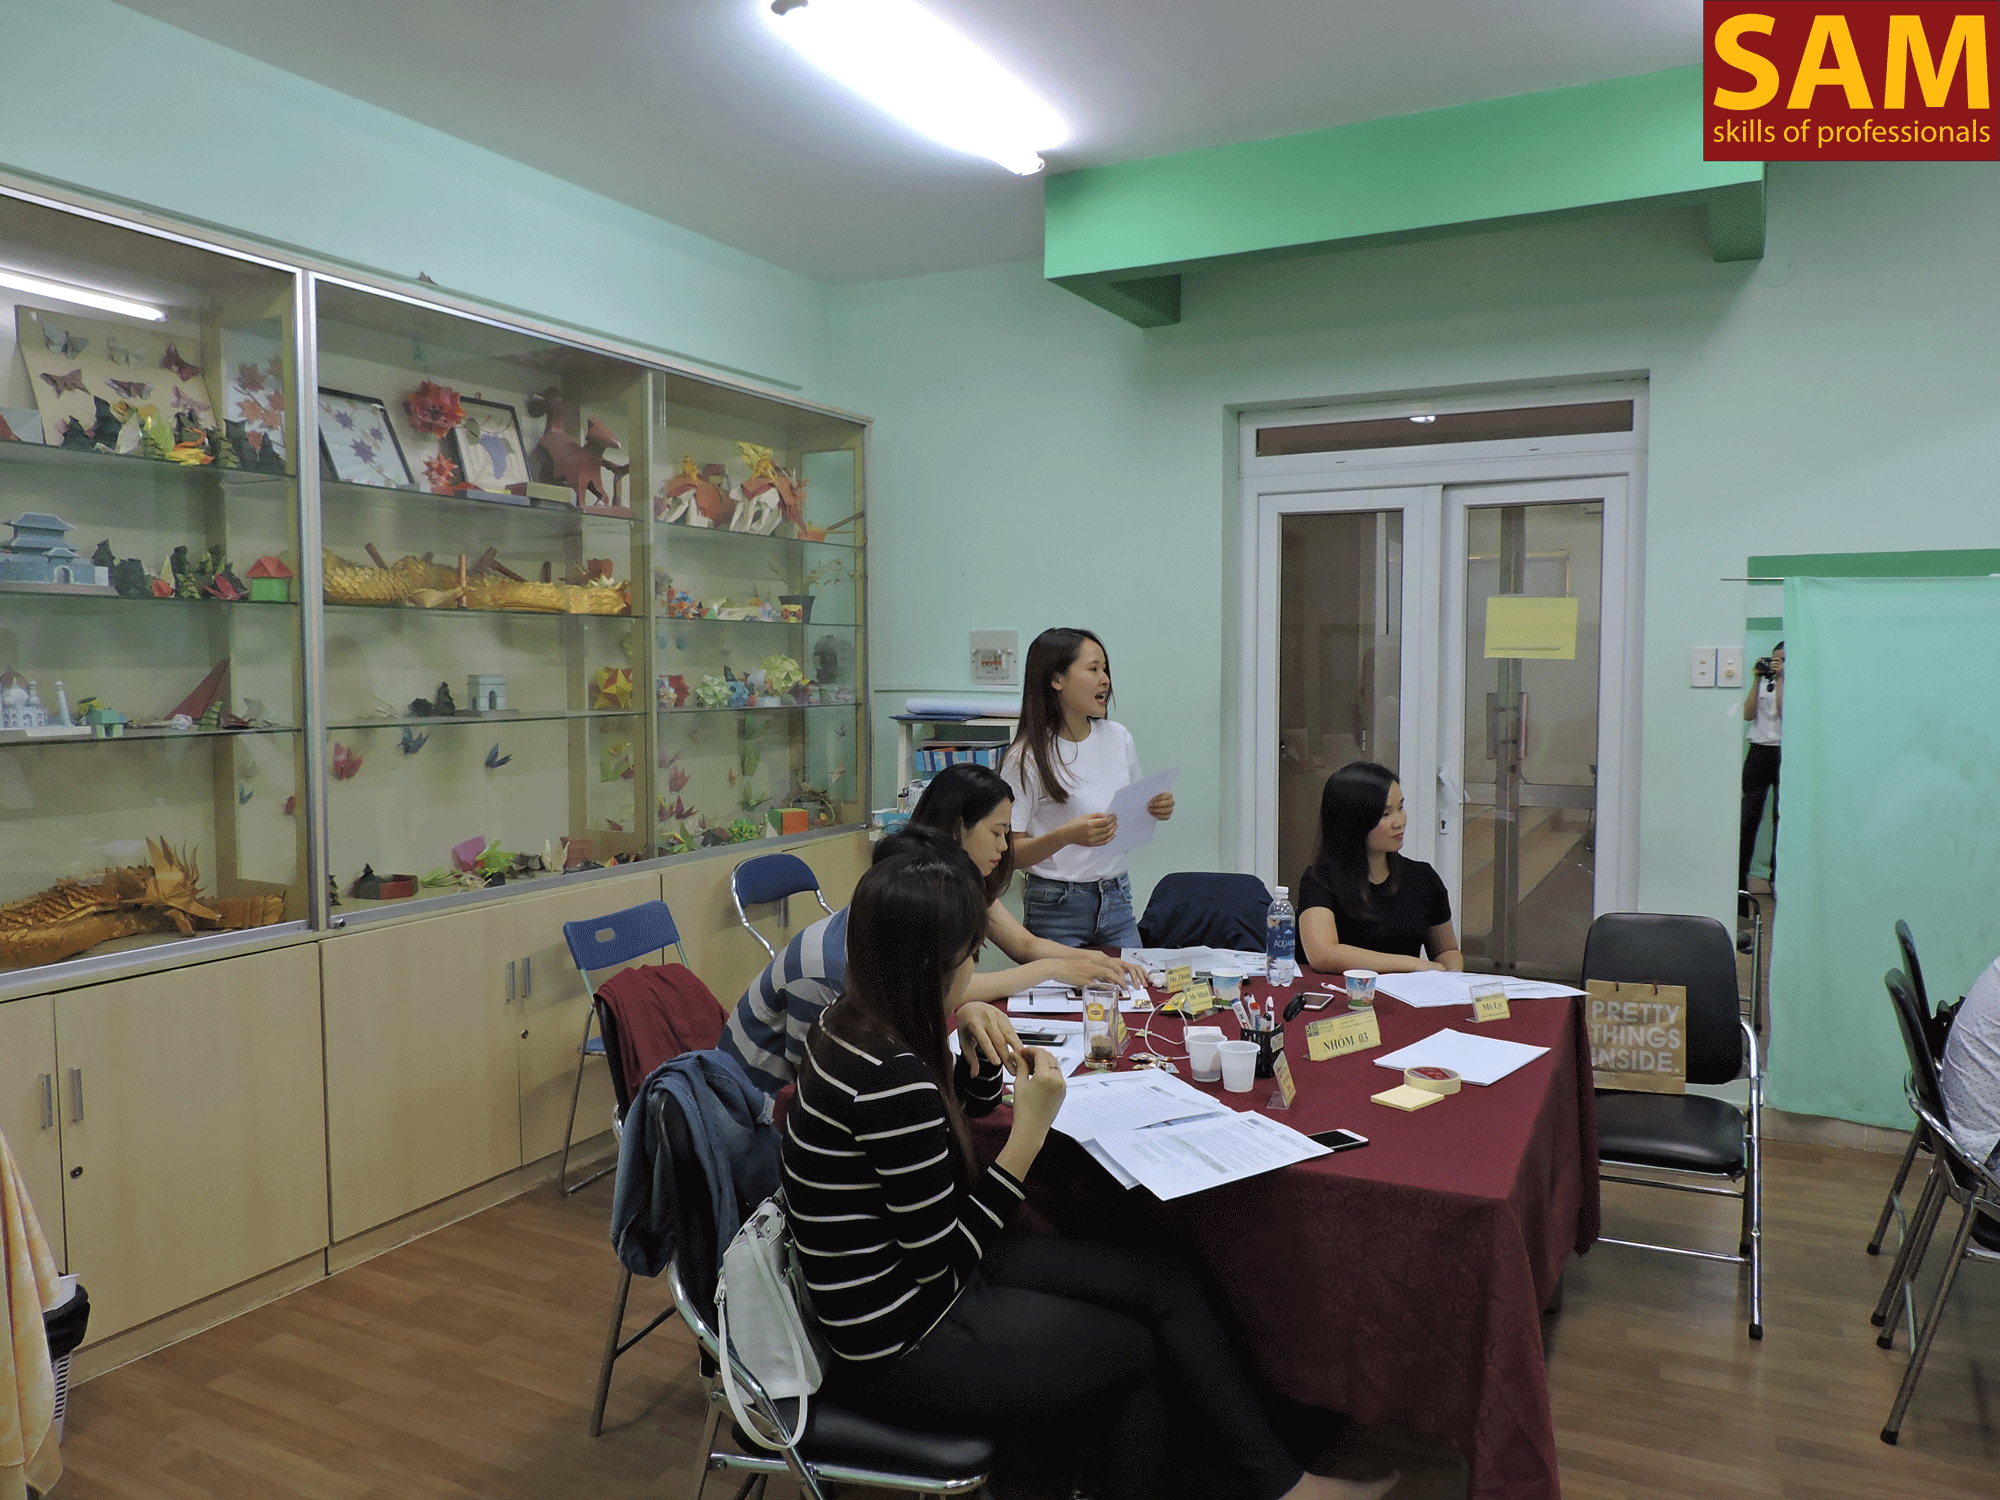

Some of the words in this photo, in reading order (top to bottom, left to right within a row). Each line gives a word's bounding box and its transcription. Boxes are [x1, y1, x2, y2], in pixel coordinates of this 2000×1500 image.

[1482, 1002, 1493, 1011] Ms
[1494, 1002, 1503, 1011] Ly
[1592, 1000, 1680, 1024] PRETTY
[1323, 1034, 1355, 1053] NHÓM
[1358, 1032, 1369, 1043] 03
[1590, 1024, 1681, 1049] THINGS
[1591, 1047, 1680, 1074] INSIDE.
